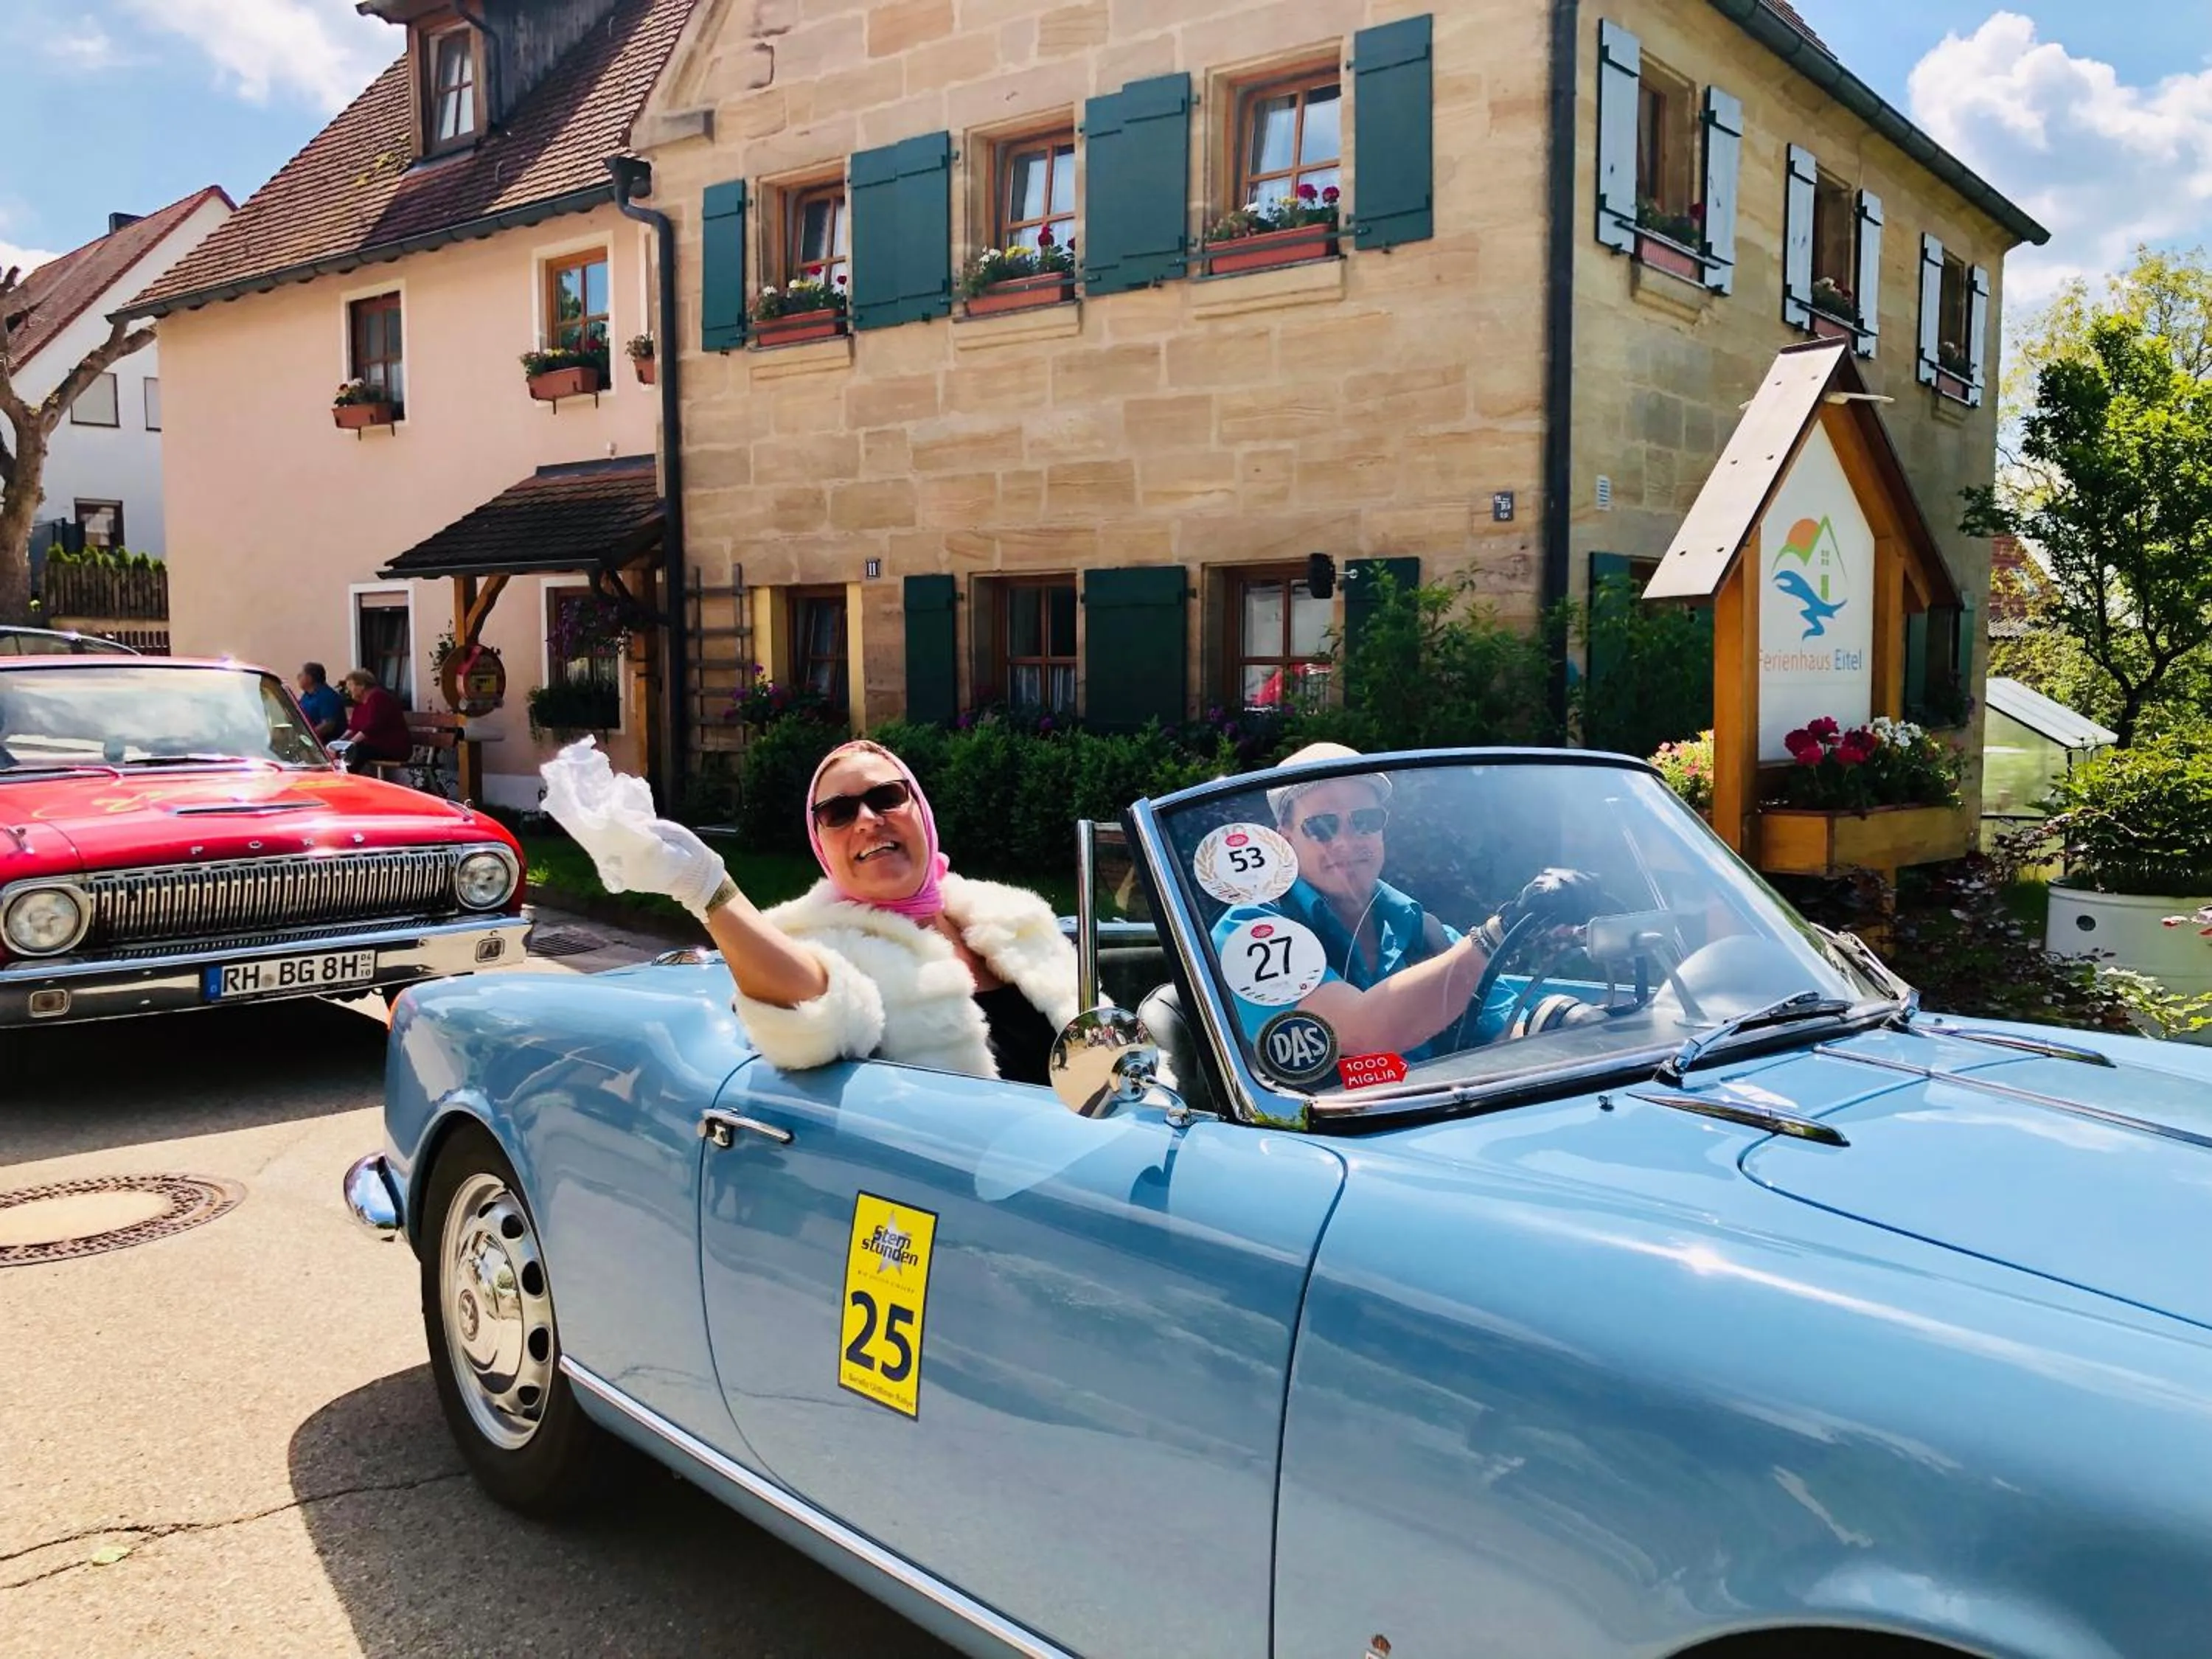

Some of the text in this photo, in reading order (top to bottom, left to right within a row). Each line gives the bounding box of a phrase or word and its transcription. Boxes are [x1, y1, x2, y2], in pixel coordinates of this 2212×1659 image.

[1758, 648, 1862, 671] Ferienhaus Eitel
[1228, 847, 1265, 872] 53
[1247, 936, 1292, 982] 27
[223, 965, 260, 993] RH
[279, 959, 315, 986] BG
[322, 955, 358, 981] 8H
[1273, 1026, 1326, 1067] DAS
[1346, 1056, 1388, 1073] 1000
[1348, 1069, 1397, 1087] MIGLIA
[861, 1238, 919, 1267] stunden
[846, 1290, 915, 1382] 25
